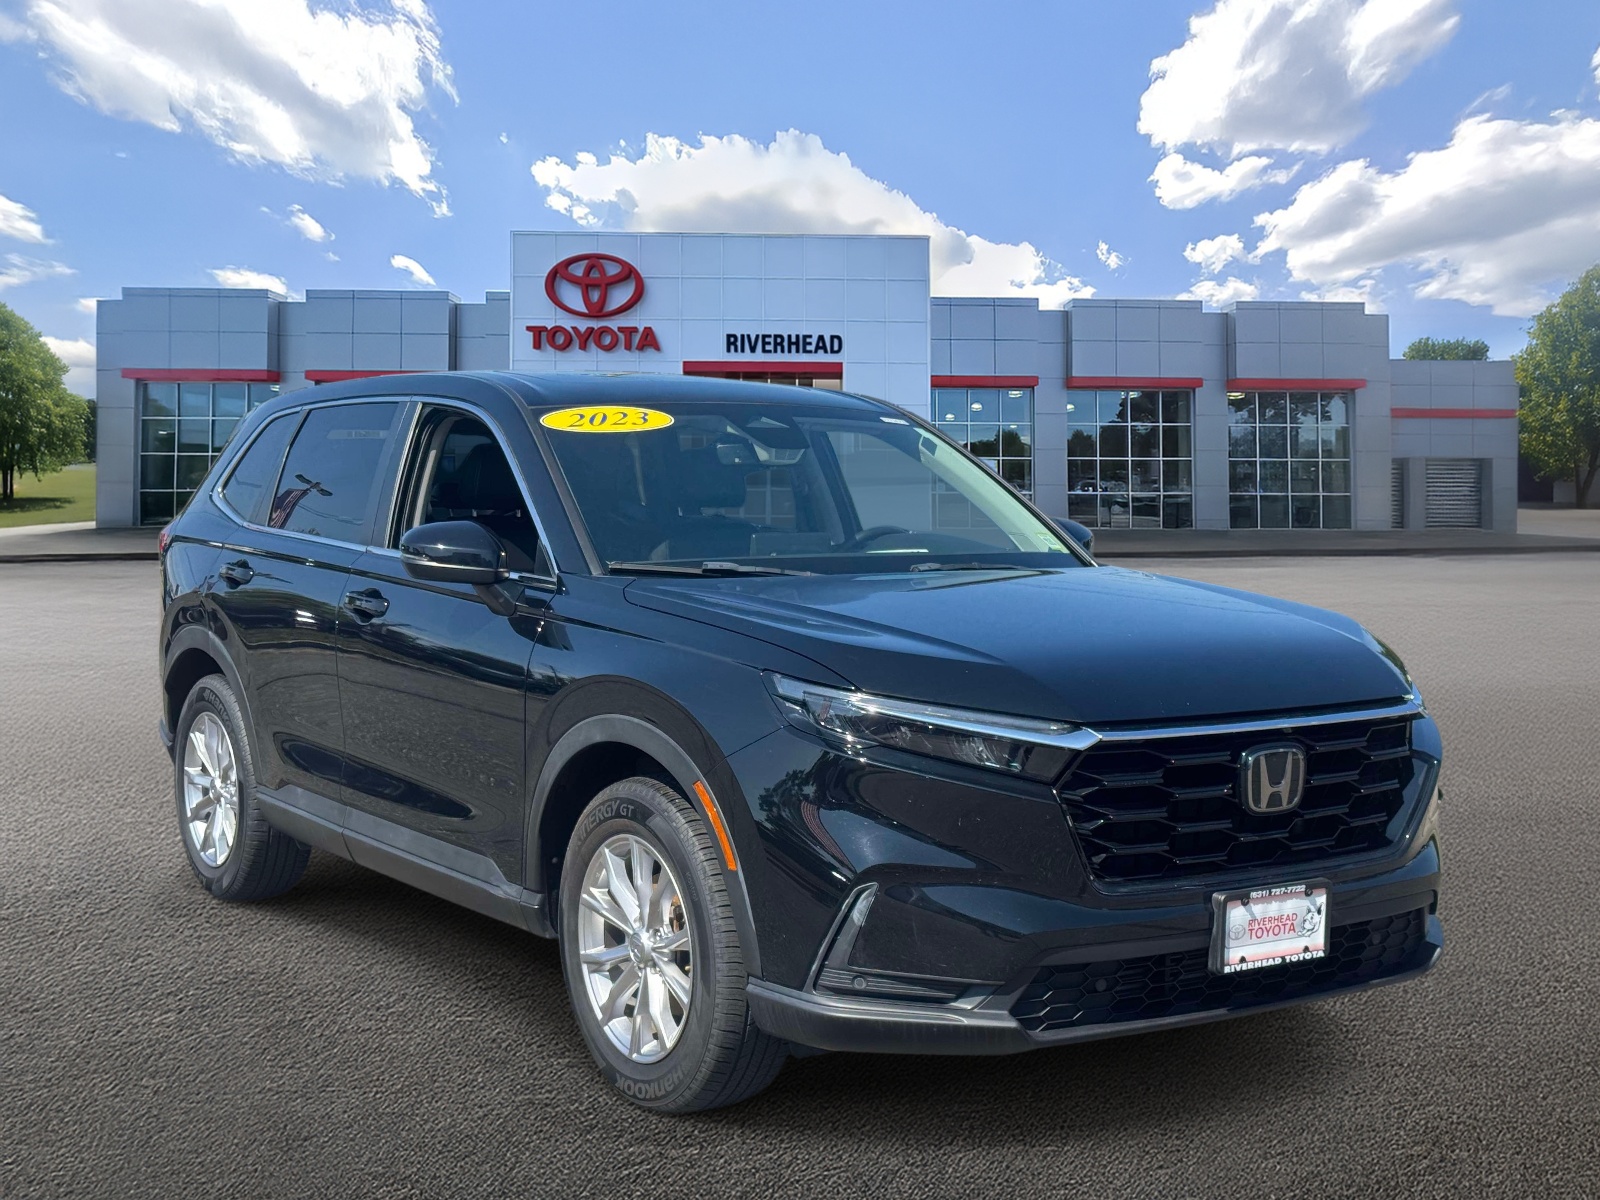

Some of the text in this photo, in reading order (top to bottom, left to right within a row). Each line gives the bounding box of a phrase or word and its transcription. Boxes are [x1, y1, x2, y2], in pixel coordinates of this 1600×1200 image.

[526, 325, 661, 351] TOYOTA
[726, 333, 843, 354] RIVERHEAD
[567, 411, 649, 428] 2023
[620, 804, 634, 817] GT
[1250, 889, 1270, 899] (631)
[1248, 912, 1298, 928] RIVERHEAD
[1248, 922, 1296, 940] TOYOTA
[1224, 949, 1325, 974] RIVERHEAD TOYOTA
